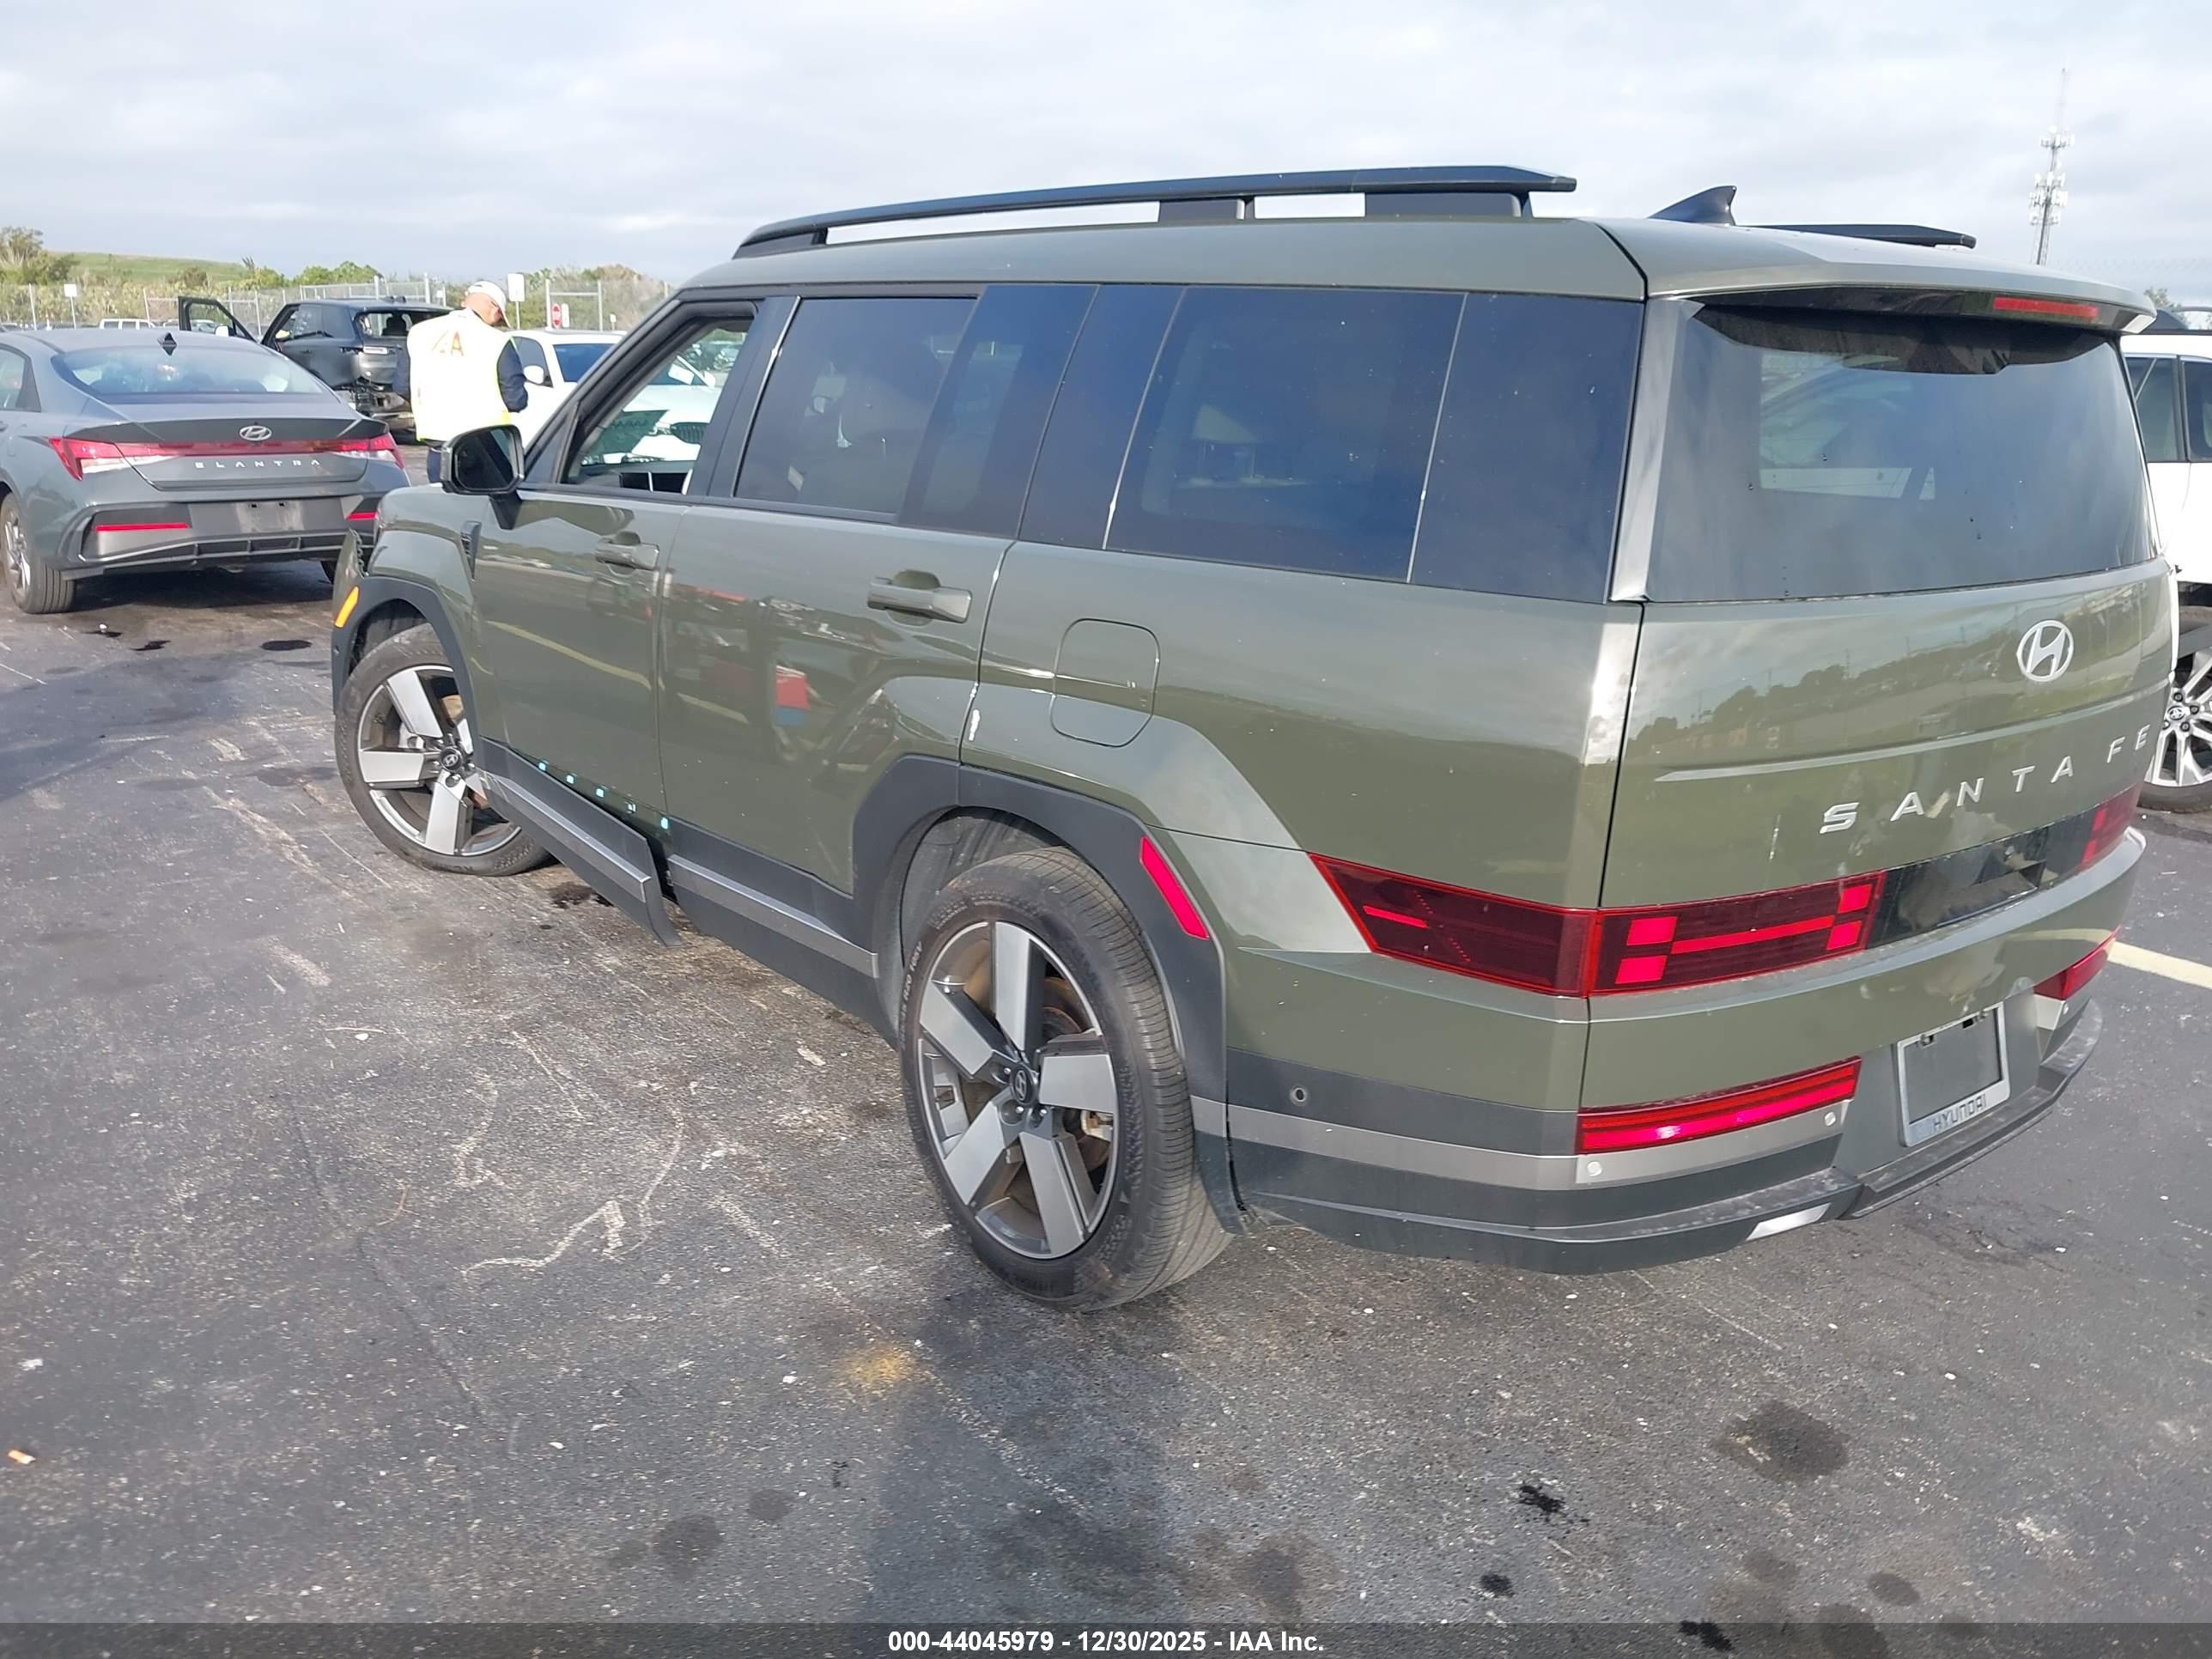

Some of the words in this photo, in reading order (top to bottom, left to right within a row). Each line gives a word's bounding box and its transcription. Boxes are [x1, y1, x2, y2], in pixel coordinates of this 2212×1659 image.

[194, 459, 321, 469] ELANTRA
[1820, 756, 2074, 835] SANTA
[2106, 724, 2150, 763] FE
[1932, 1093, 1986, 1133] HYUNDAI
